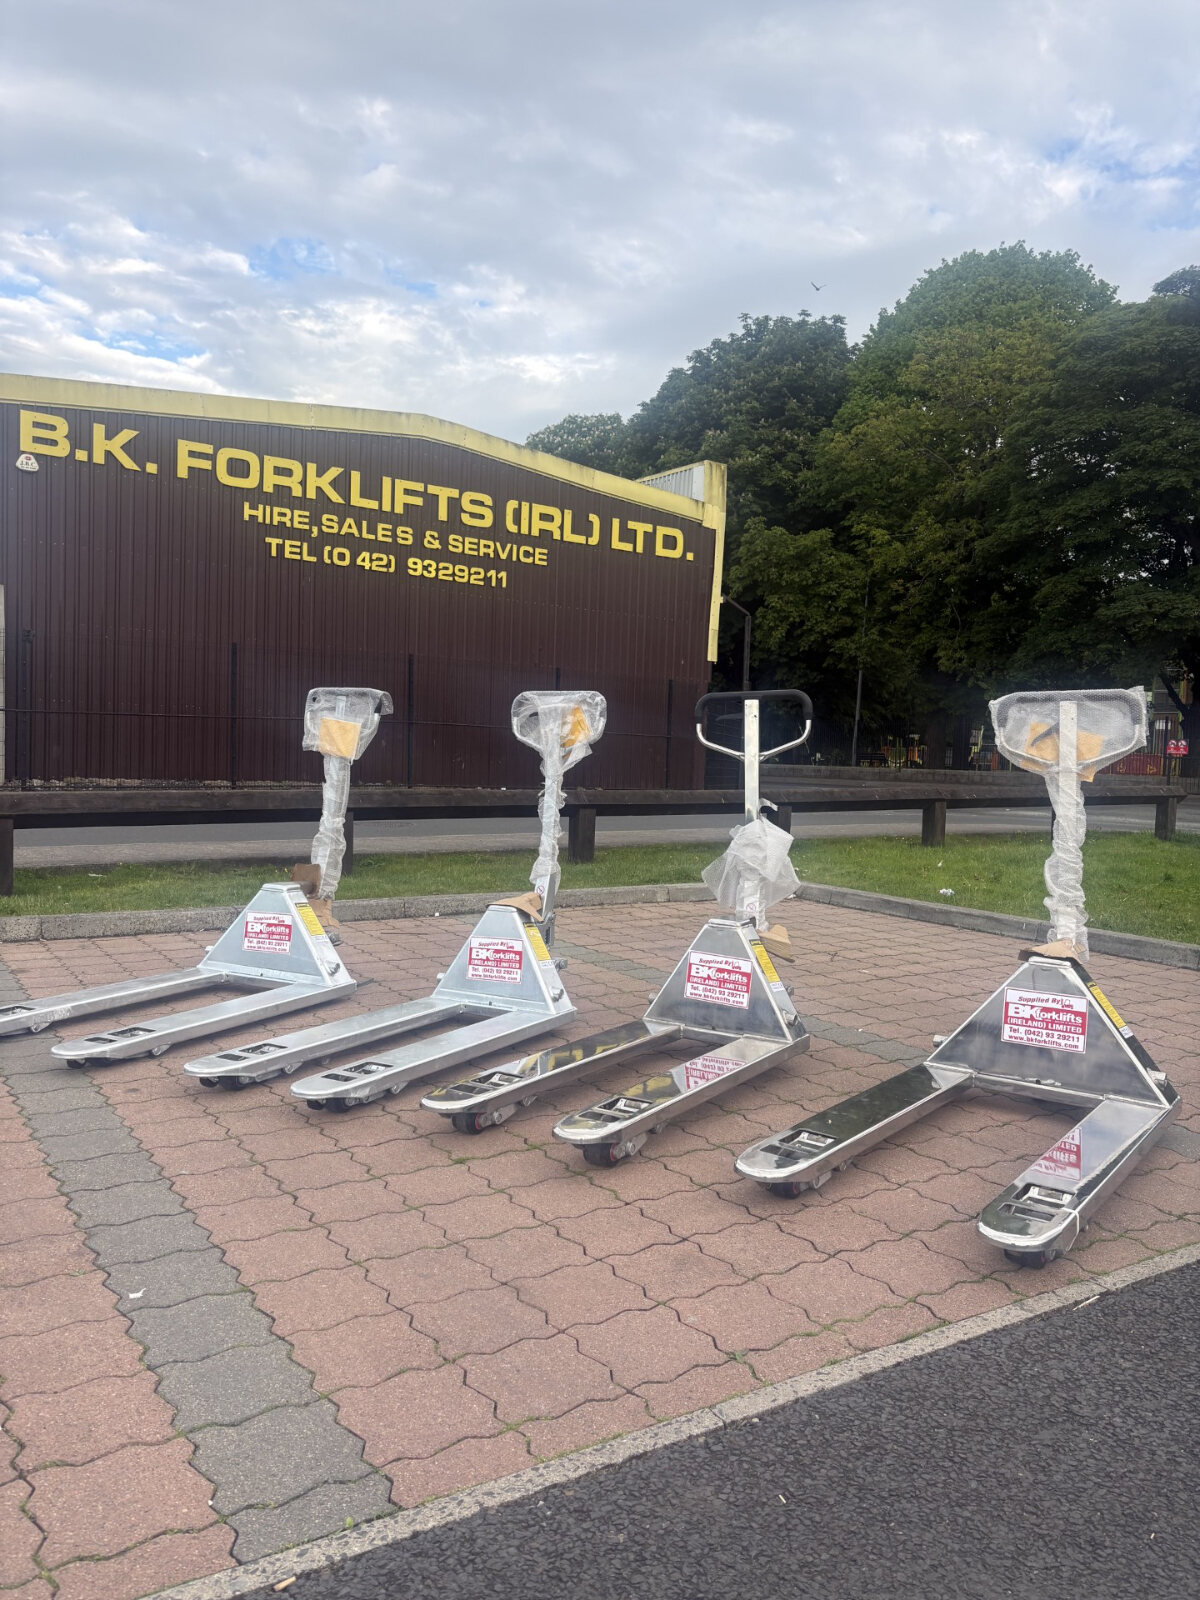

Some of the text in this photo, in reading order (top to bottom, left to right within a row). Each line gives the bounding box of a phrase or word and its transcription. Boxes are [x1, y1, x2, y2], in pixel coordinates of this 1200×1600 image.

[20, 410, 695, 561] B.K. FORKLIFTS (IRL) LTD.
[423, 530, 442, 550] &
[447, 533, 548, 567] SERVICE
[264, 536, 317, 563] TEL
[407, 557, 507, 588] 9329211
[721, 982, 747, 992] LIMITED
[1017, 996, 1050, 1004] Supplied
[1007, 1017, 1046, 1029] (IRELAND)
[1048, 1022, 1083, 1033] LIMITED
[1008, 1026, 1080, 1043] Tel. (042) 93 29211
